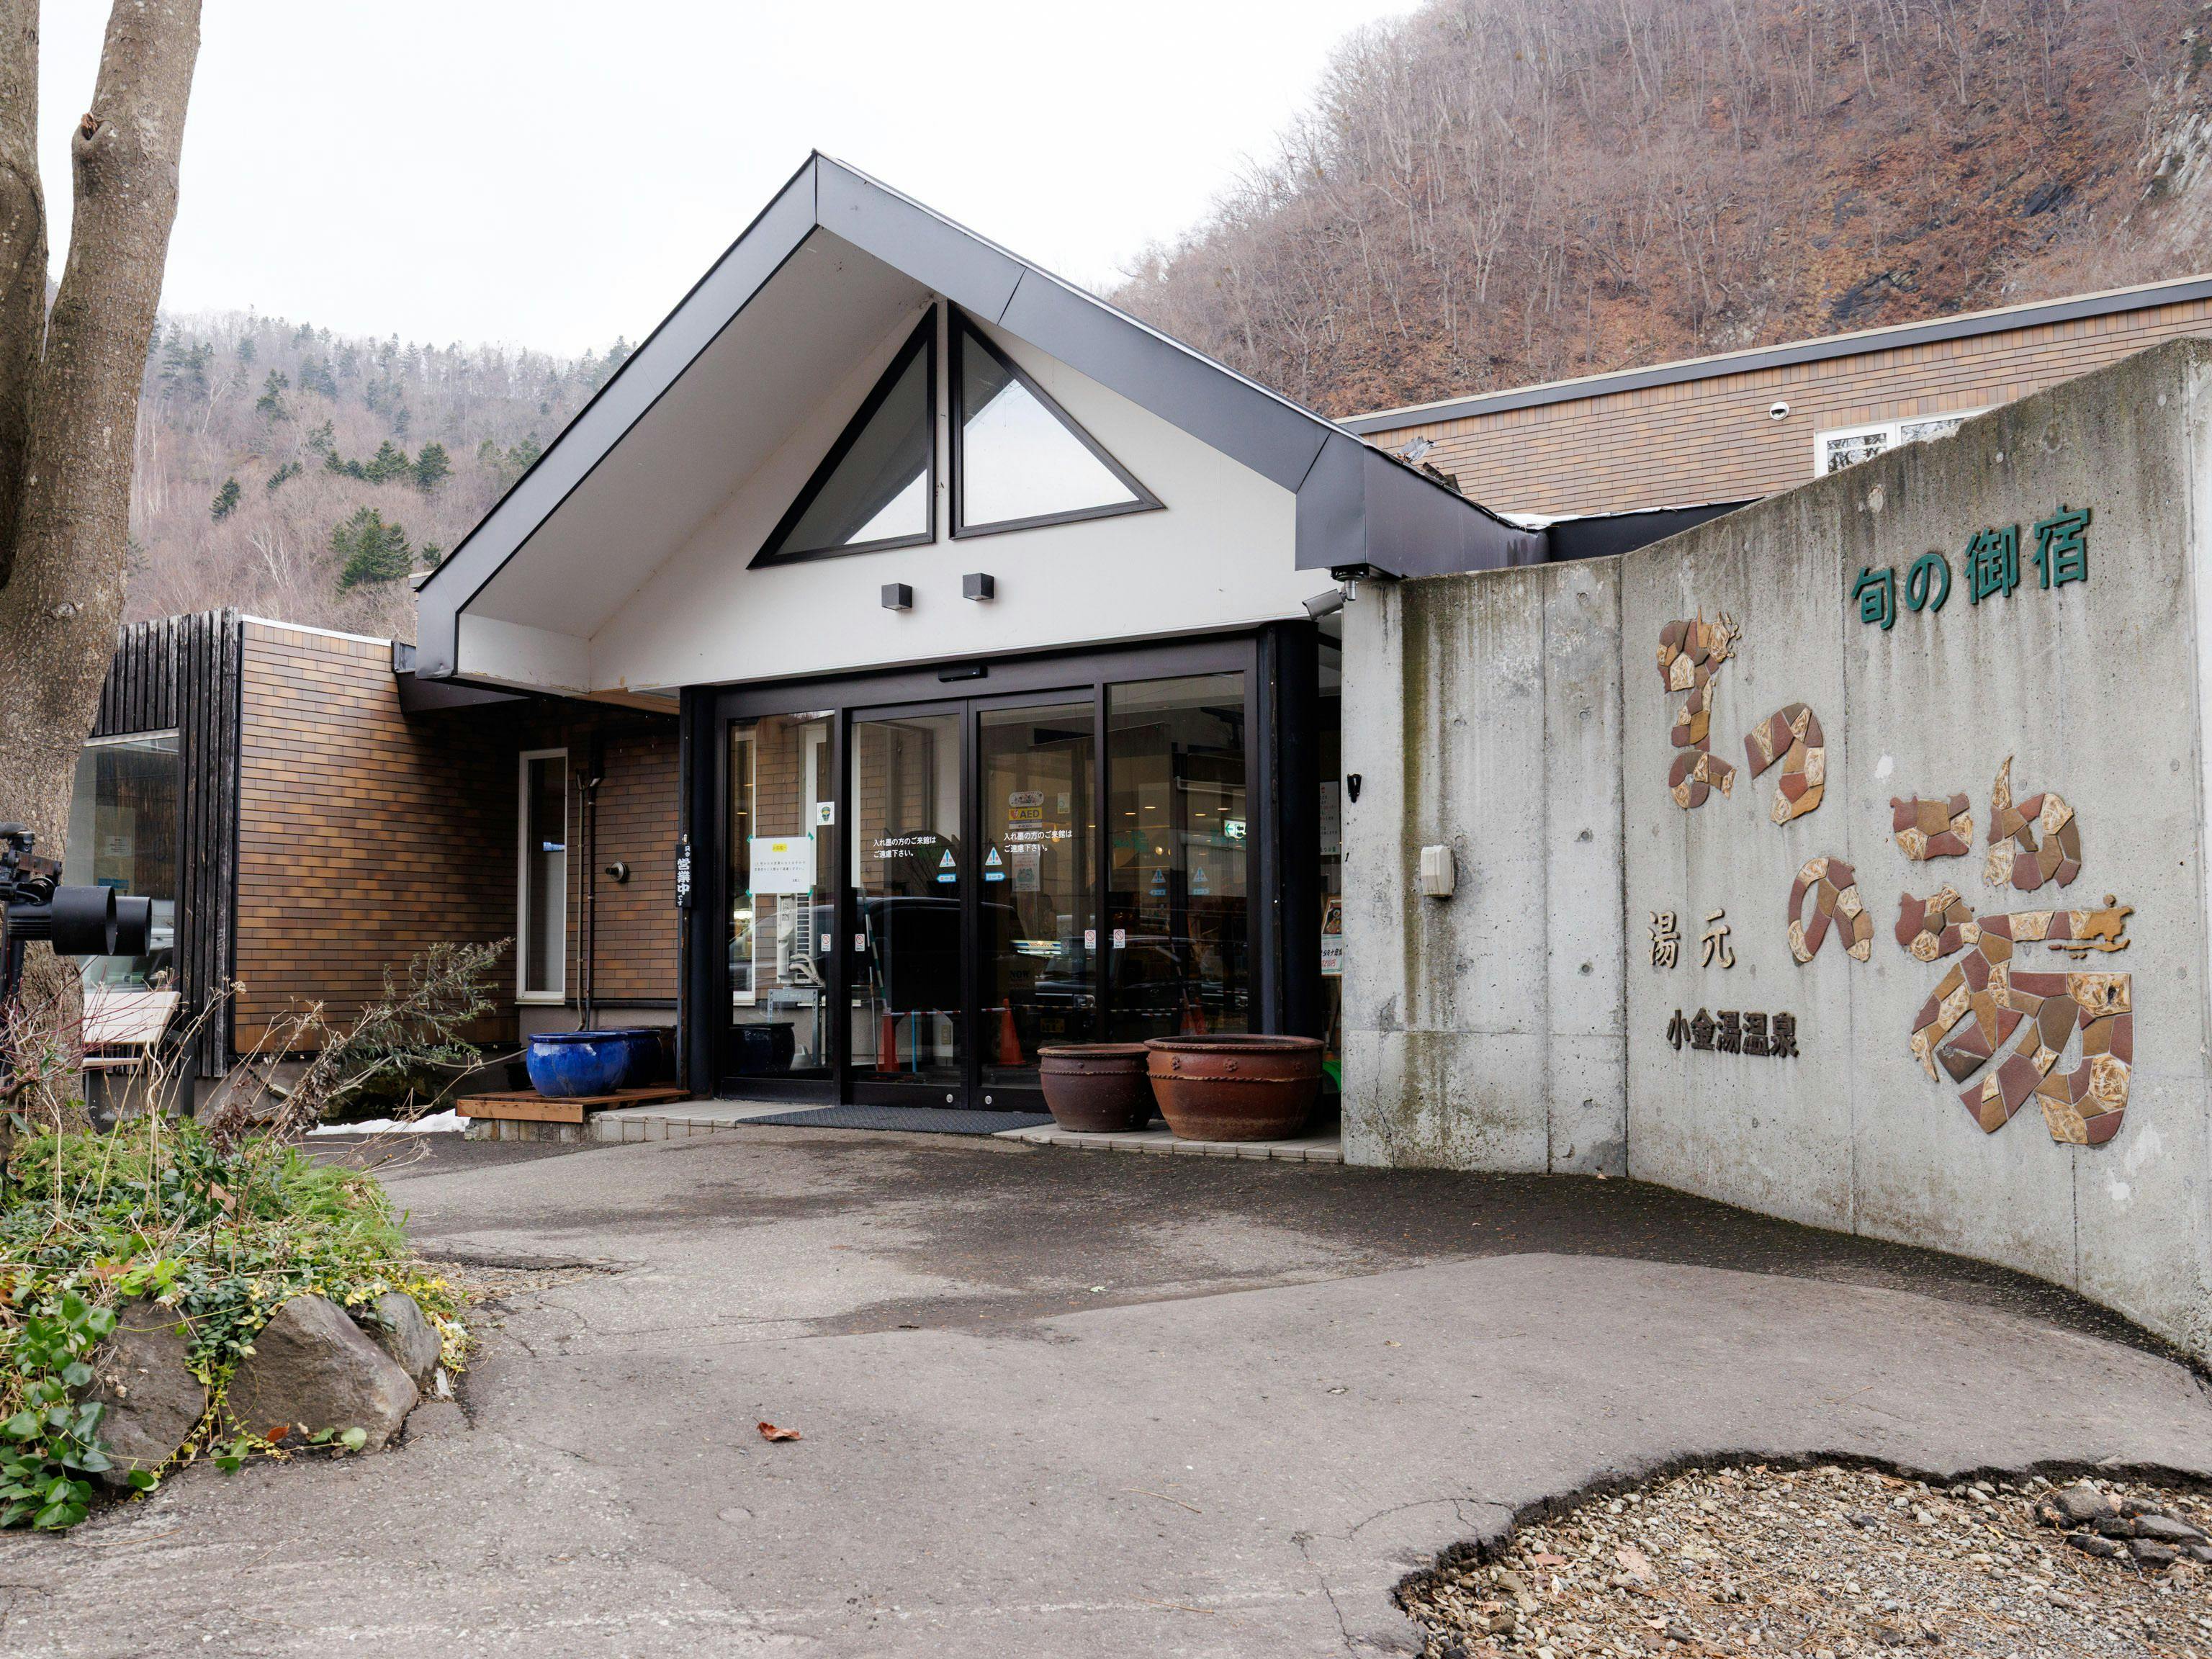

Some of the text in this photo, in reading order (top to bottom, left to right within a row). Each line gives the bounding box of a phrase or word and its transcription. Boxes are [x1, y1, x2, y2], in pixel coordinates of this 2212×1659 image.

[1851, 505, 2091, 630] 旬の御宿
[1020, 809, 1040, 819] AED
[873, 836, 936, 847] 入れ墨の方のご来館は
[1003, 830, 1072, 841] 入れ墨の方のご来館は
[1648, 908, 1735, 969] 湯元
[1665, 1008, 1799, 1057] 小金湯温泉
